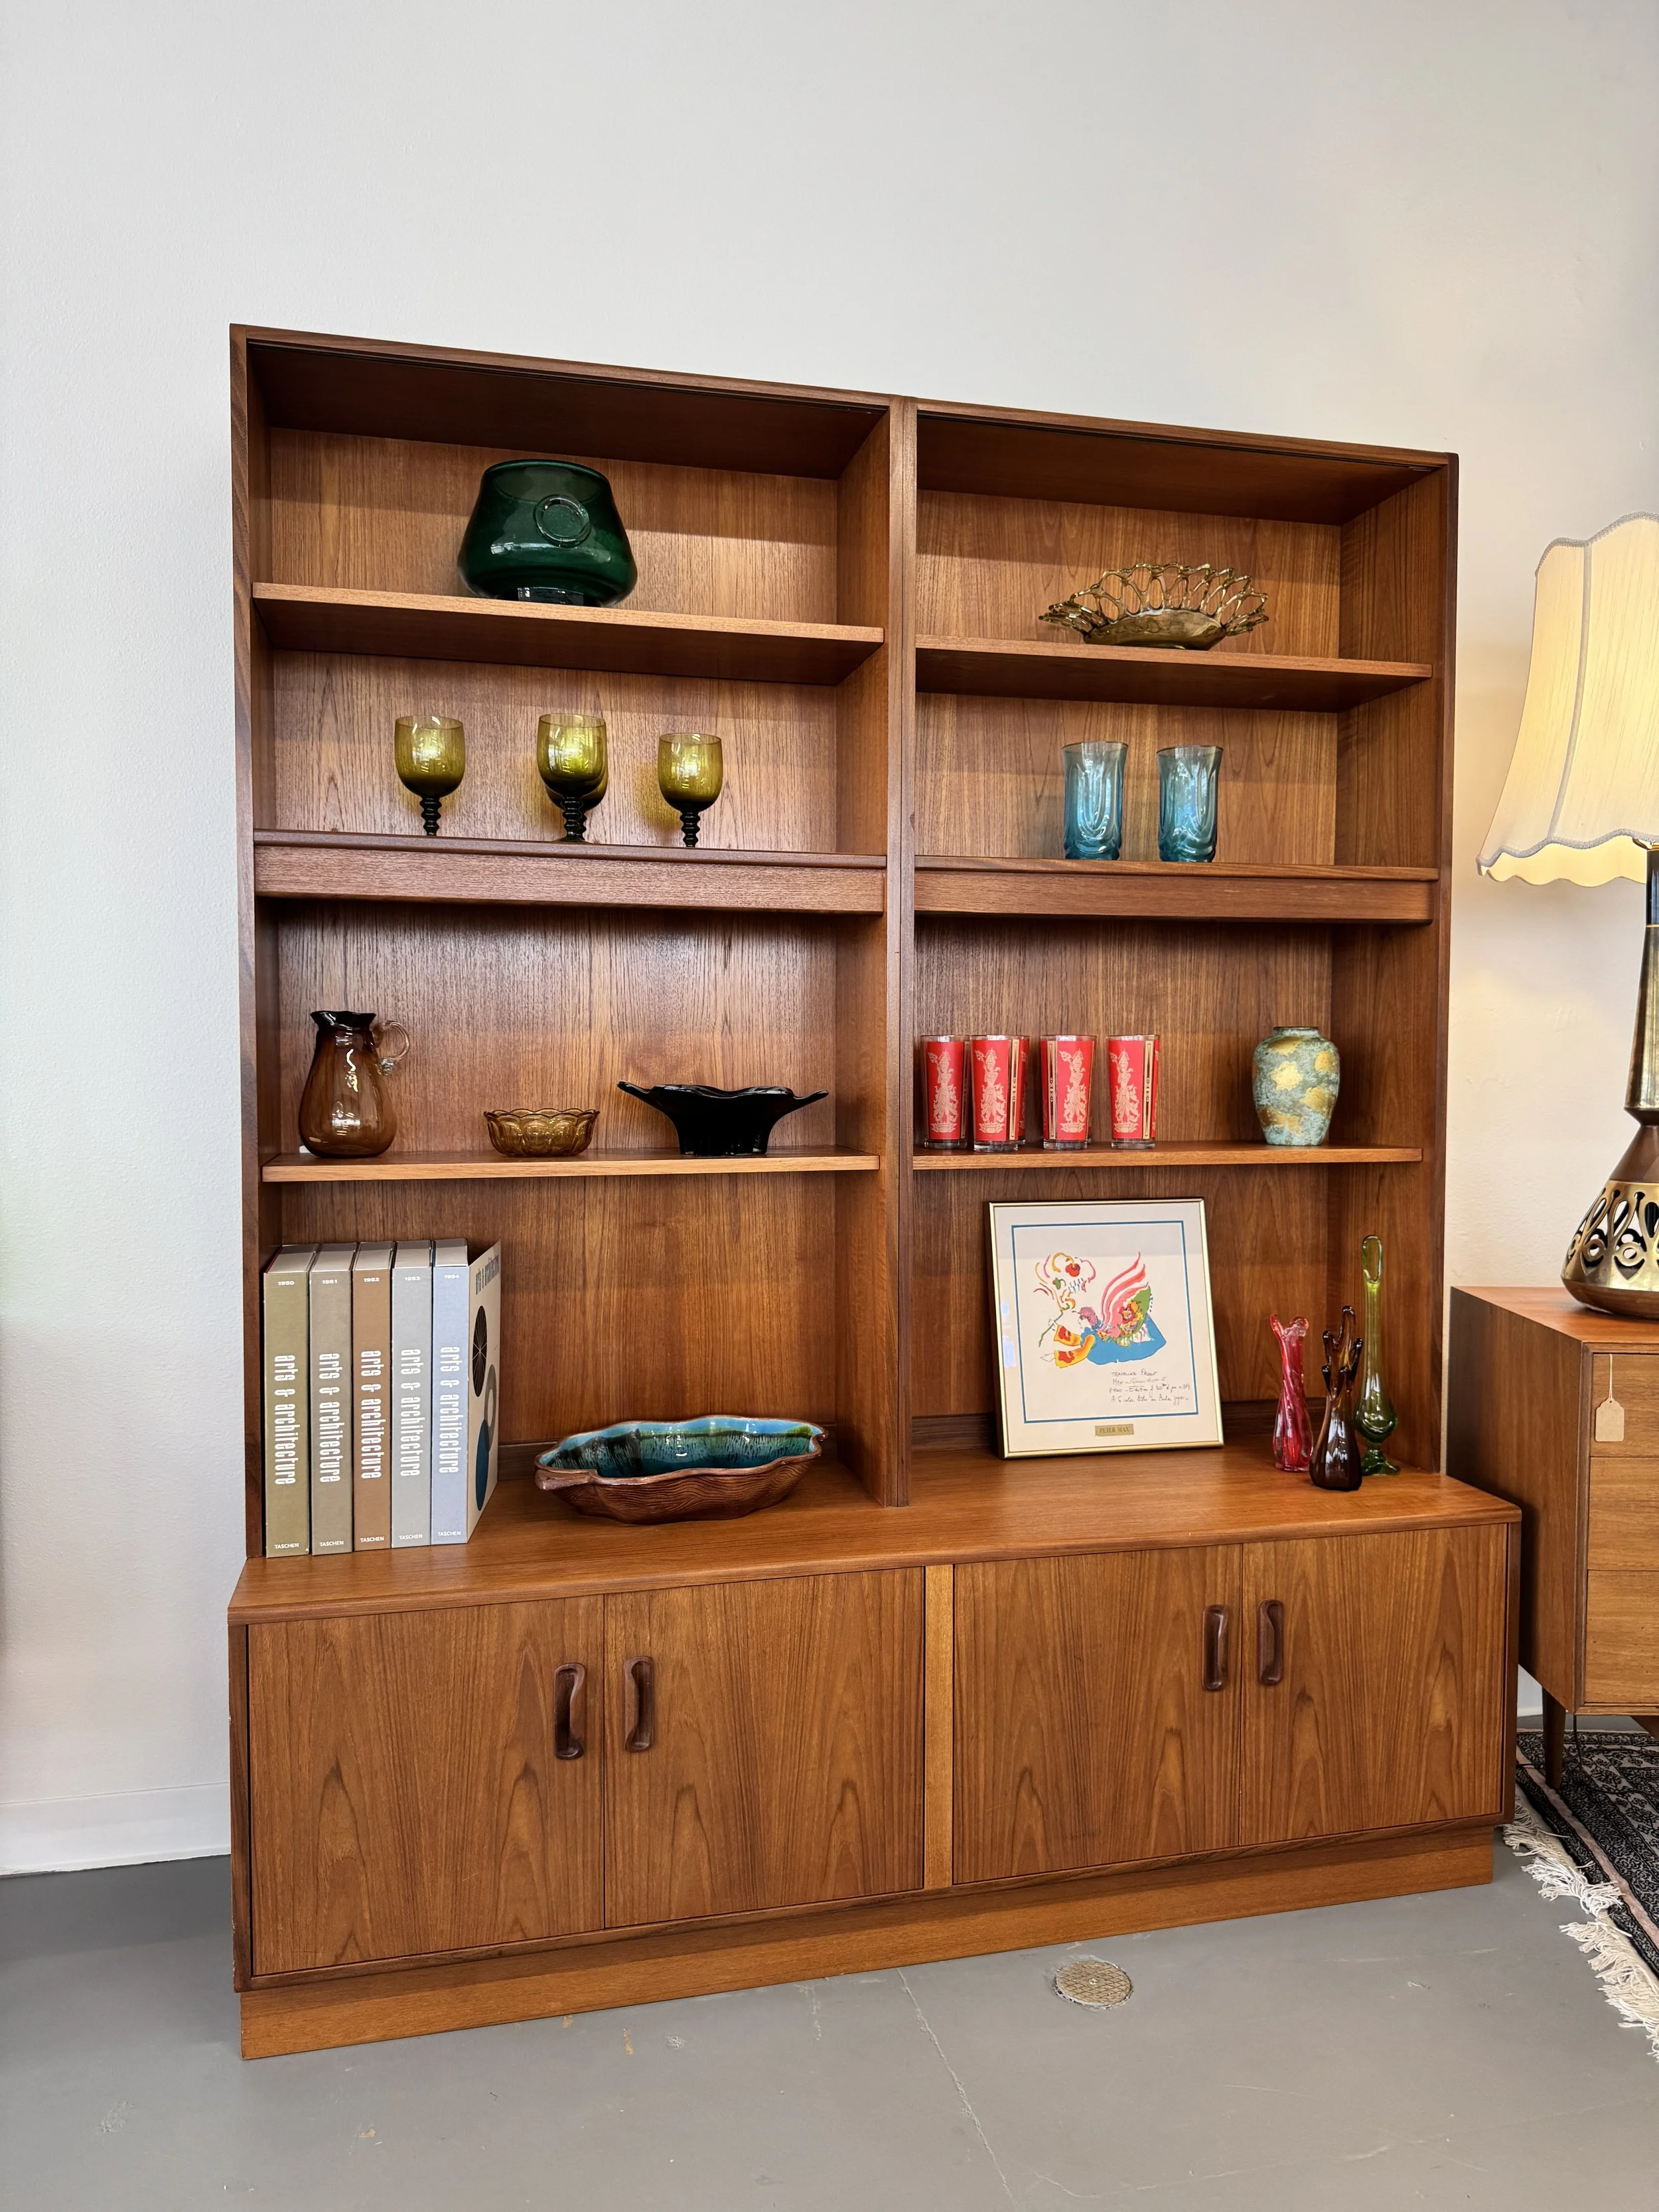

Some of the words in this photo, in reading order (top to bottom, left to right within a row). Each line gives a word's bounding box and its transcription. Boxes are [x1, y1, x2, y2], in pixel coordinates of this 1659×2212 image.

[274, 1355, 299, 1381] arts
[319, 1353, 343, 1380] arts
[360, 1350, 384, 1376] arts
[400, 1349, 424, 1375] arts
[440, 1347, 463, 1372] arts
[274, 1404, 301, 1485] architecture
[319, 1401, 345, 1483] architecture
[361, 1398, 386, 1479] architecture
[400, 1396, 425, 1477] architecture
[439, 1394, 464, 1473] architecture
